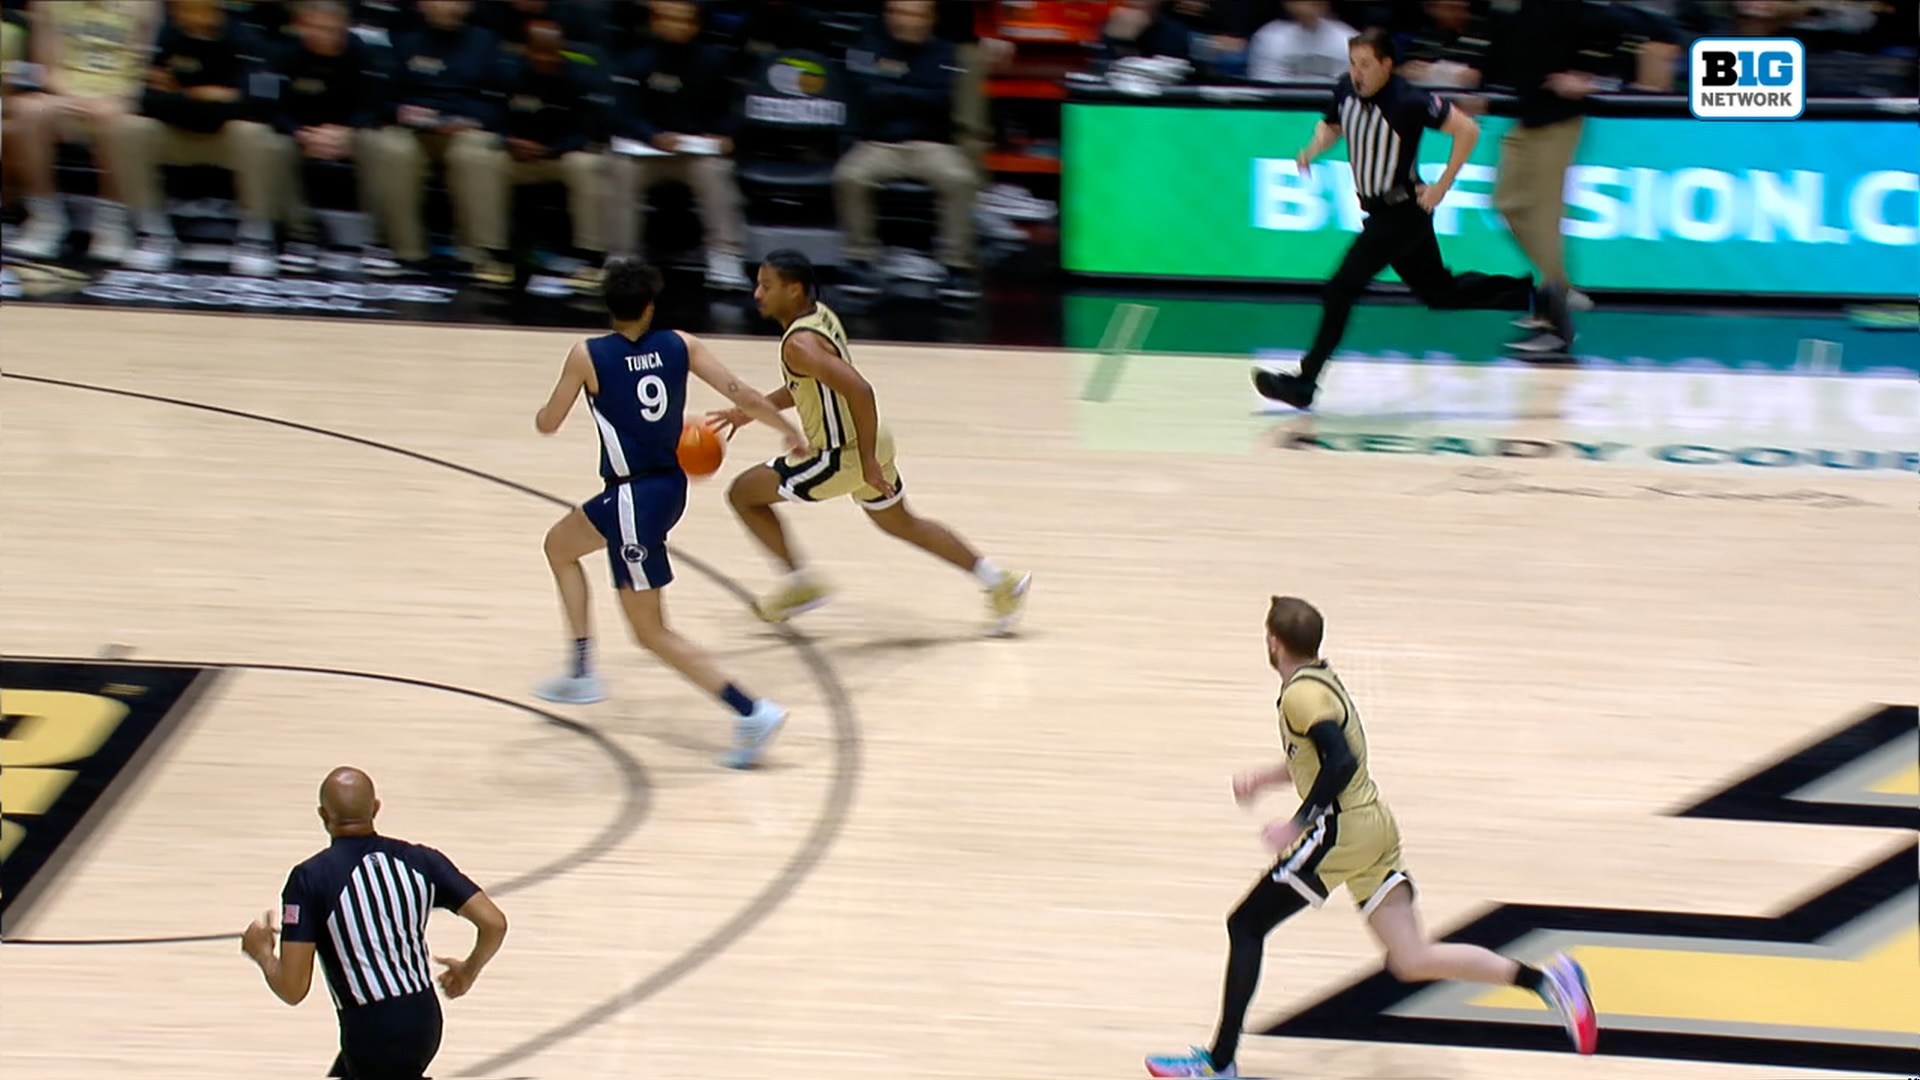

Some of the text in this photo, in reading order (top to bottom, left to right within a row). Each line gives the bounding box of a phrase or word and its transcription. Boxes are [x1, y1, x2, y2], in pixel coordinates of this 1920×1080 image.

[1252, 157, 1919, 245] BFSION.C
[625, 351, 663, 371] TUNCA
[637, 374, 668, 422] 9
